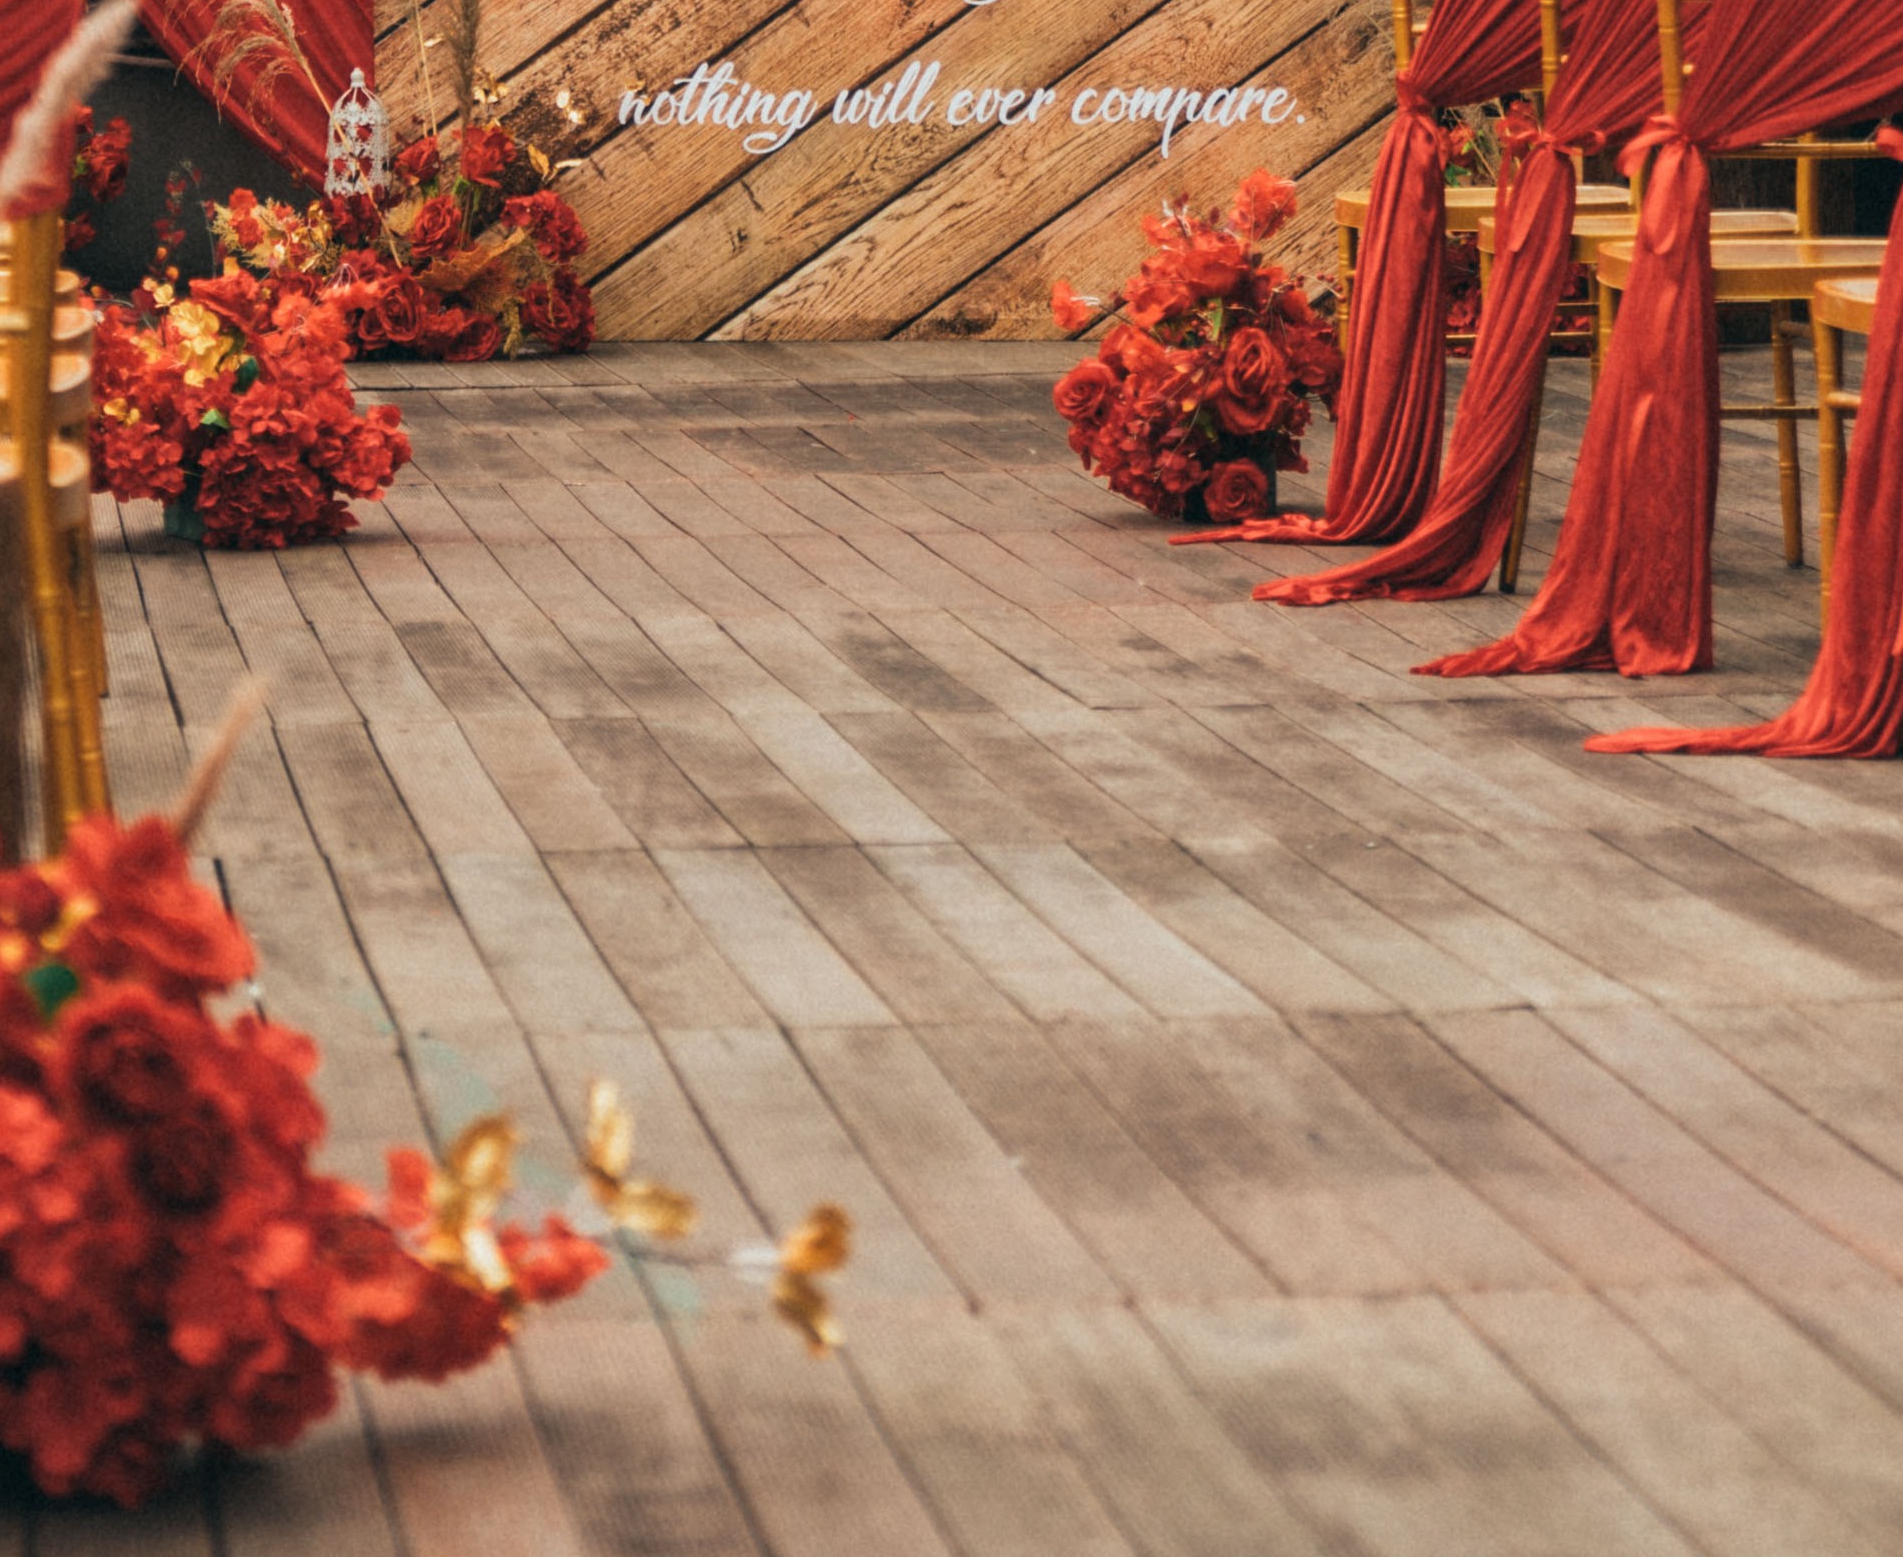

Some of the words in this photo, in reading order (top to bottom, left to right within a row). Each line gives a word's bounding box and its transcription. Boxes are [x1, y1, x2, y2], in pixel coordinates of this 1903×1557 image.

[618, 61, 817, 155] nothing
[831, 60, 941, 129] will
[946, 88, 1056, 126] ever
[1070, 86, 1305, 158] compare.
